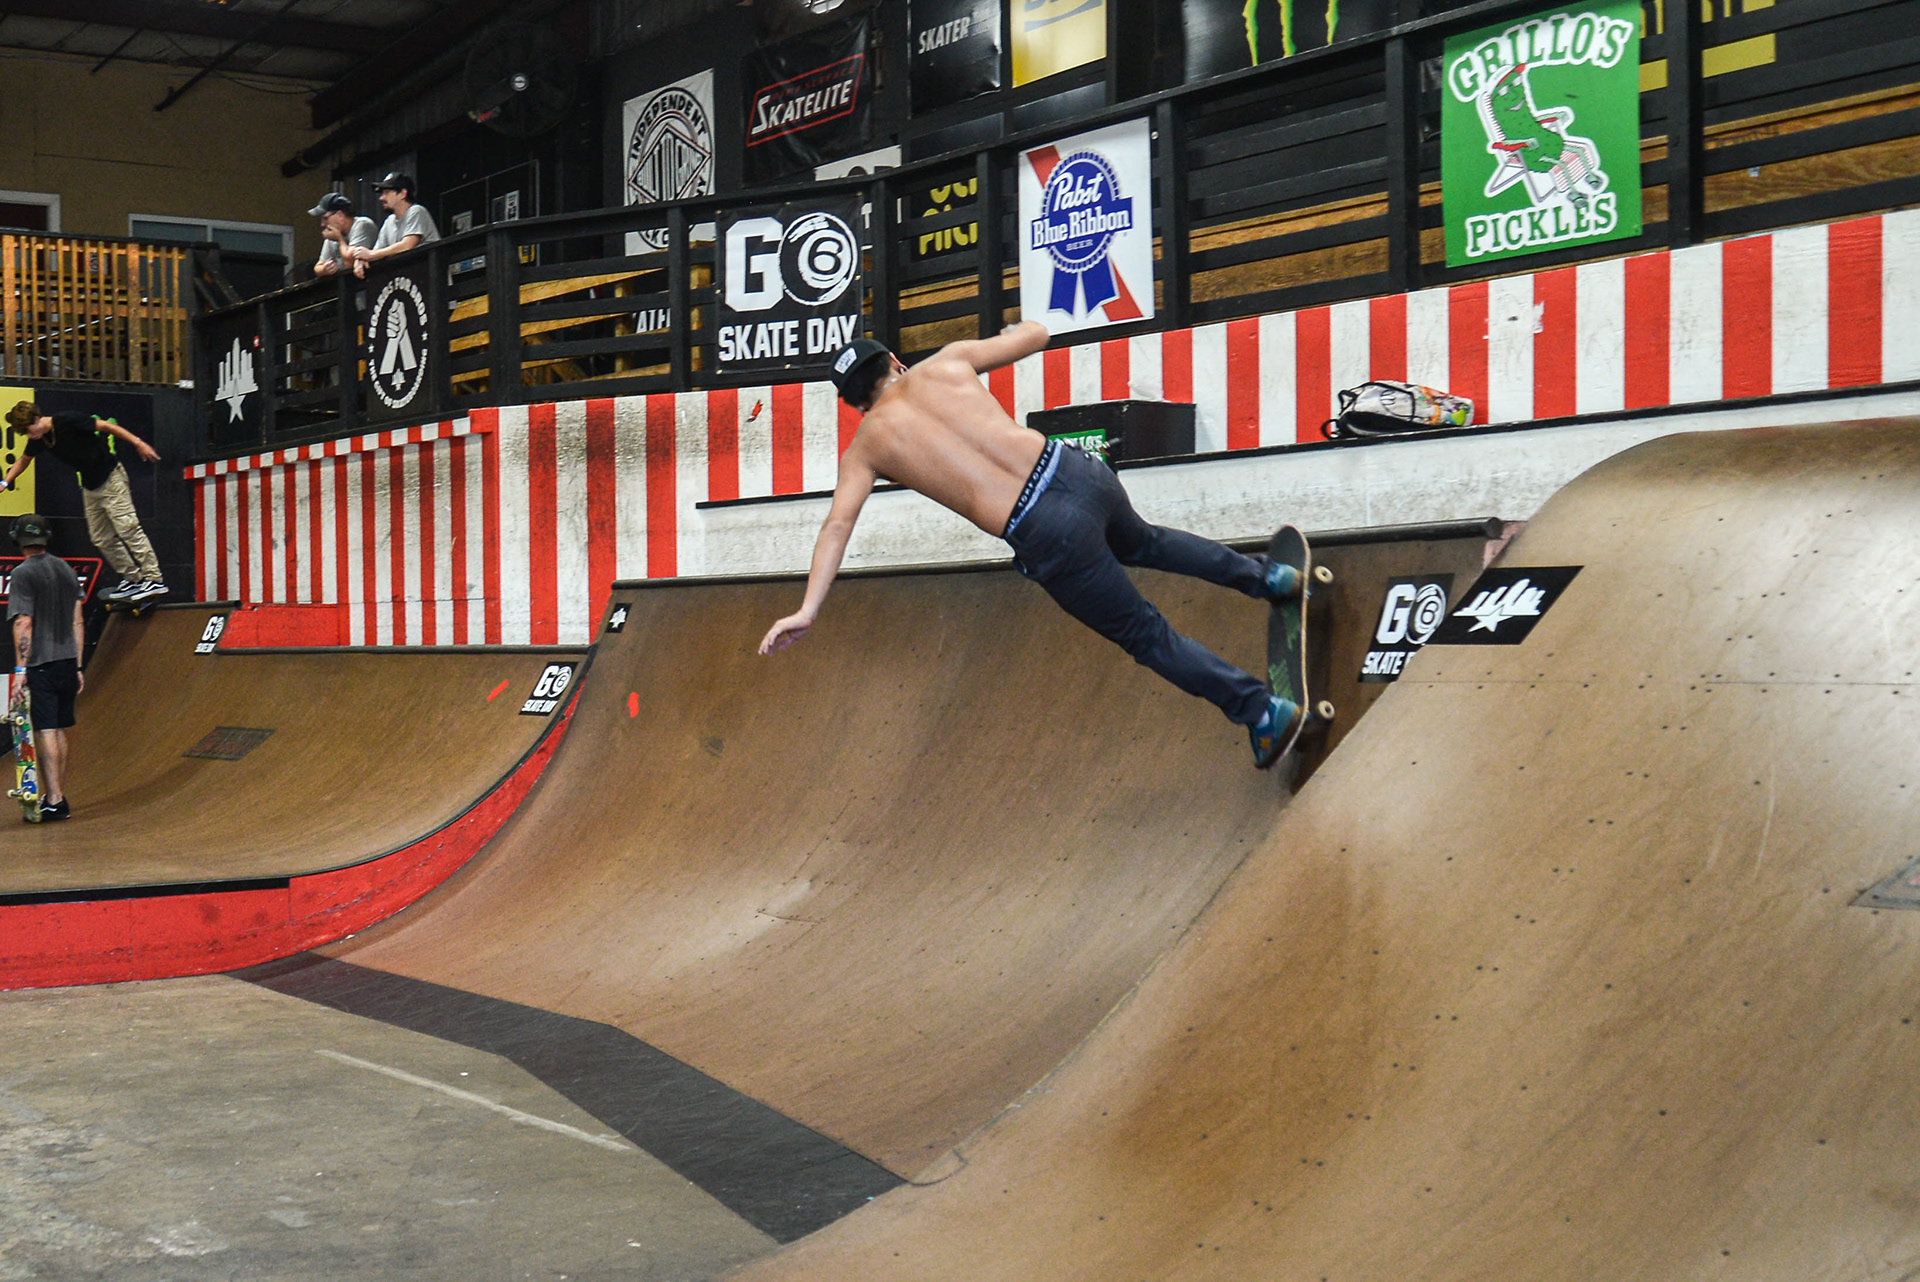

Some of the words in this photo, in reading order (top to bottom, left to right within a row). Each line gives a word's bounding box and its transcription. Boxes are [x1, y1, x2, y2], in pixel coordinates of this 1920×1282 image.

[918, 16, 971, 54] SKATER
[1450, 13, 1632, 101] GRILLO'S
[630, 94, 708, 159] INDEPENDENT
[751, 79, 853, 135] SKATELITE
[1053, 171, 1105, 212] Pabst
[1032, 217, 1069, 248] Blue
[1068, 206, 1131, 239] Ribbon
[1066, 239, 1093, 251] BEER
[1467, 194, 1616, 256] PICKLES
[718, 320, 800, 362] SKATE
[806, 314, 858, 354] DAY
[1361, 651, 1406, 675] SKATE
